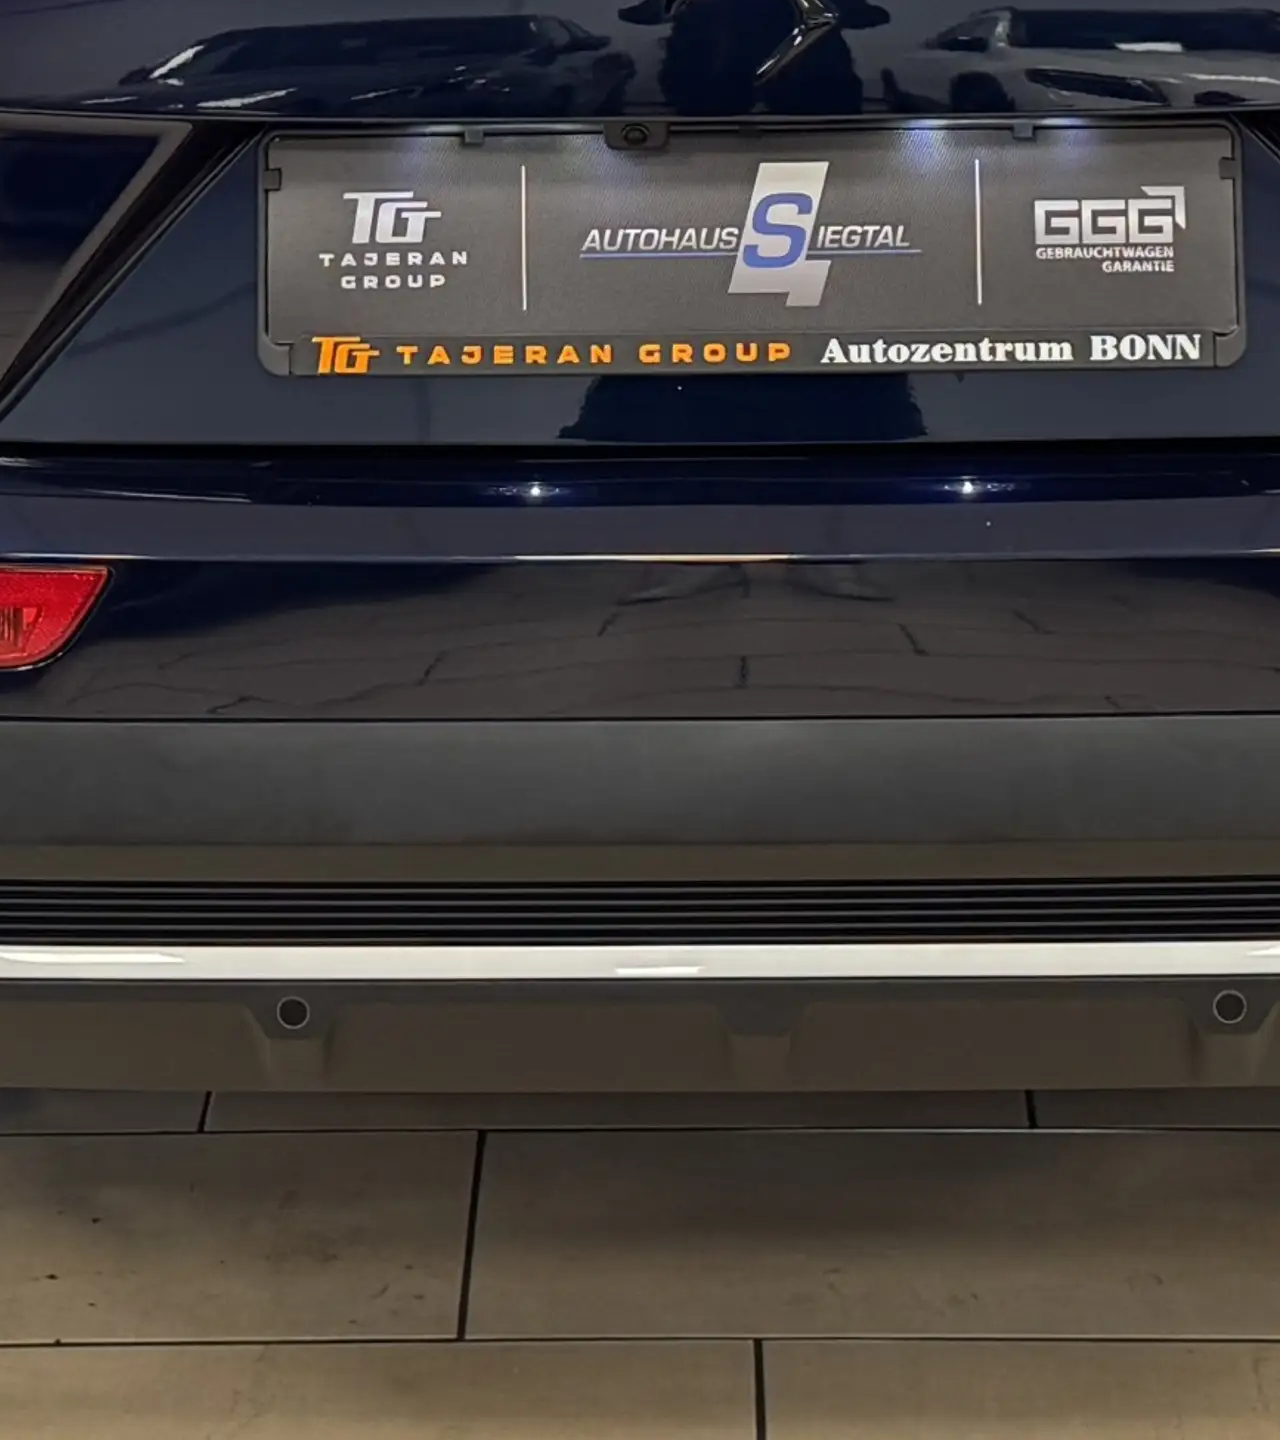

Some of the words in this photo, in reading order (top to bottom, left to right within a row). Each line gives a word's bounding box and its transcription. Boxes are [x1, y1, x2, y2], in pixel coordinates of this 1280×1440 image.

[1034, 198, 1174, 244] GGG
[581, 227, 739, 252] AUTOHAUS
[319, 251, 468, 267] TAJERAN
[1036, 246, 1174, 259] GEBRAUCHTWAGEN
[1102, 260, 1175, 273] GARANTIE
[341, 274, 446, 289] GROUP
[397, 345, 613, 364] TAJERAN
[638, 343, 791, 363] GROUP
[820, 338, 1073, 364] Autozentrum
[1089, 334, 1202, 360] BONN
